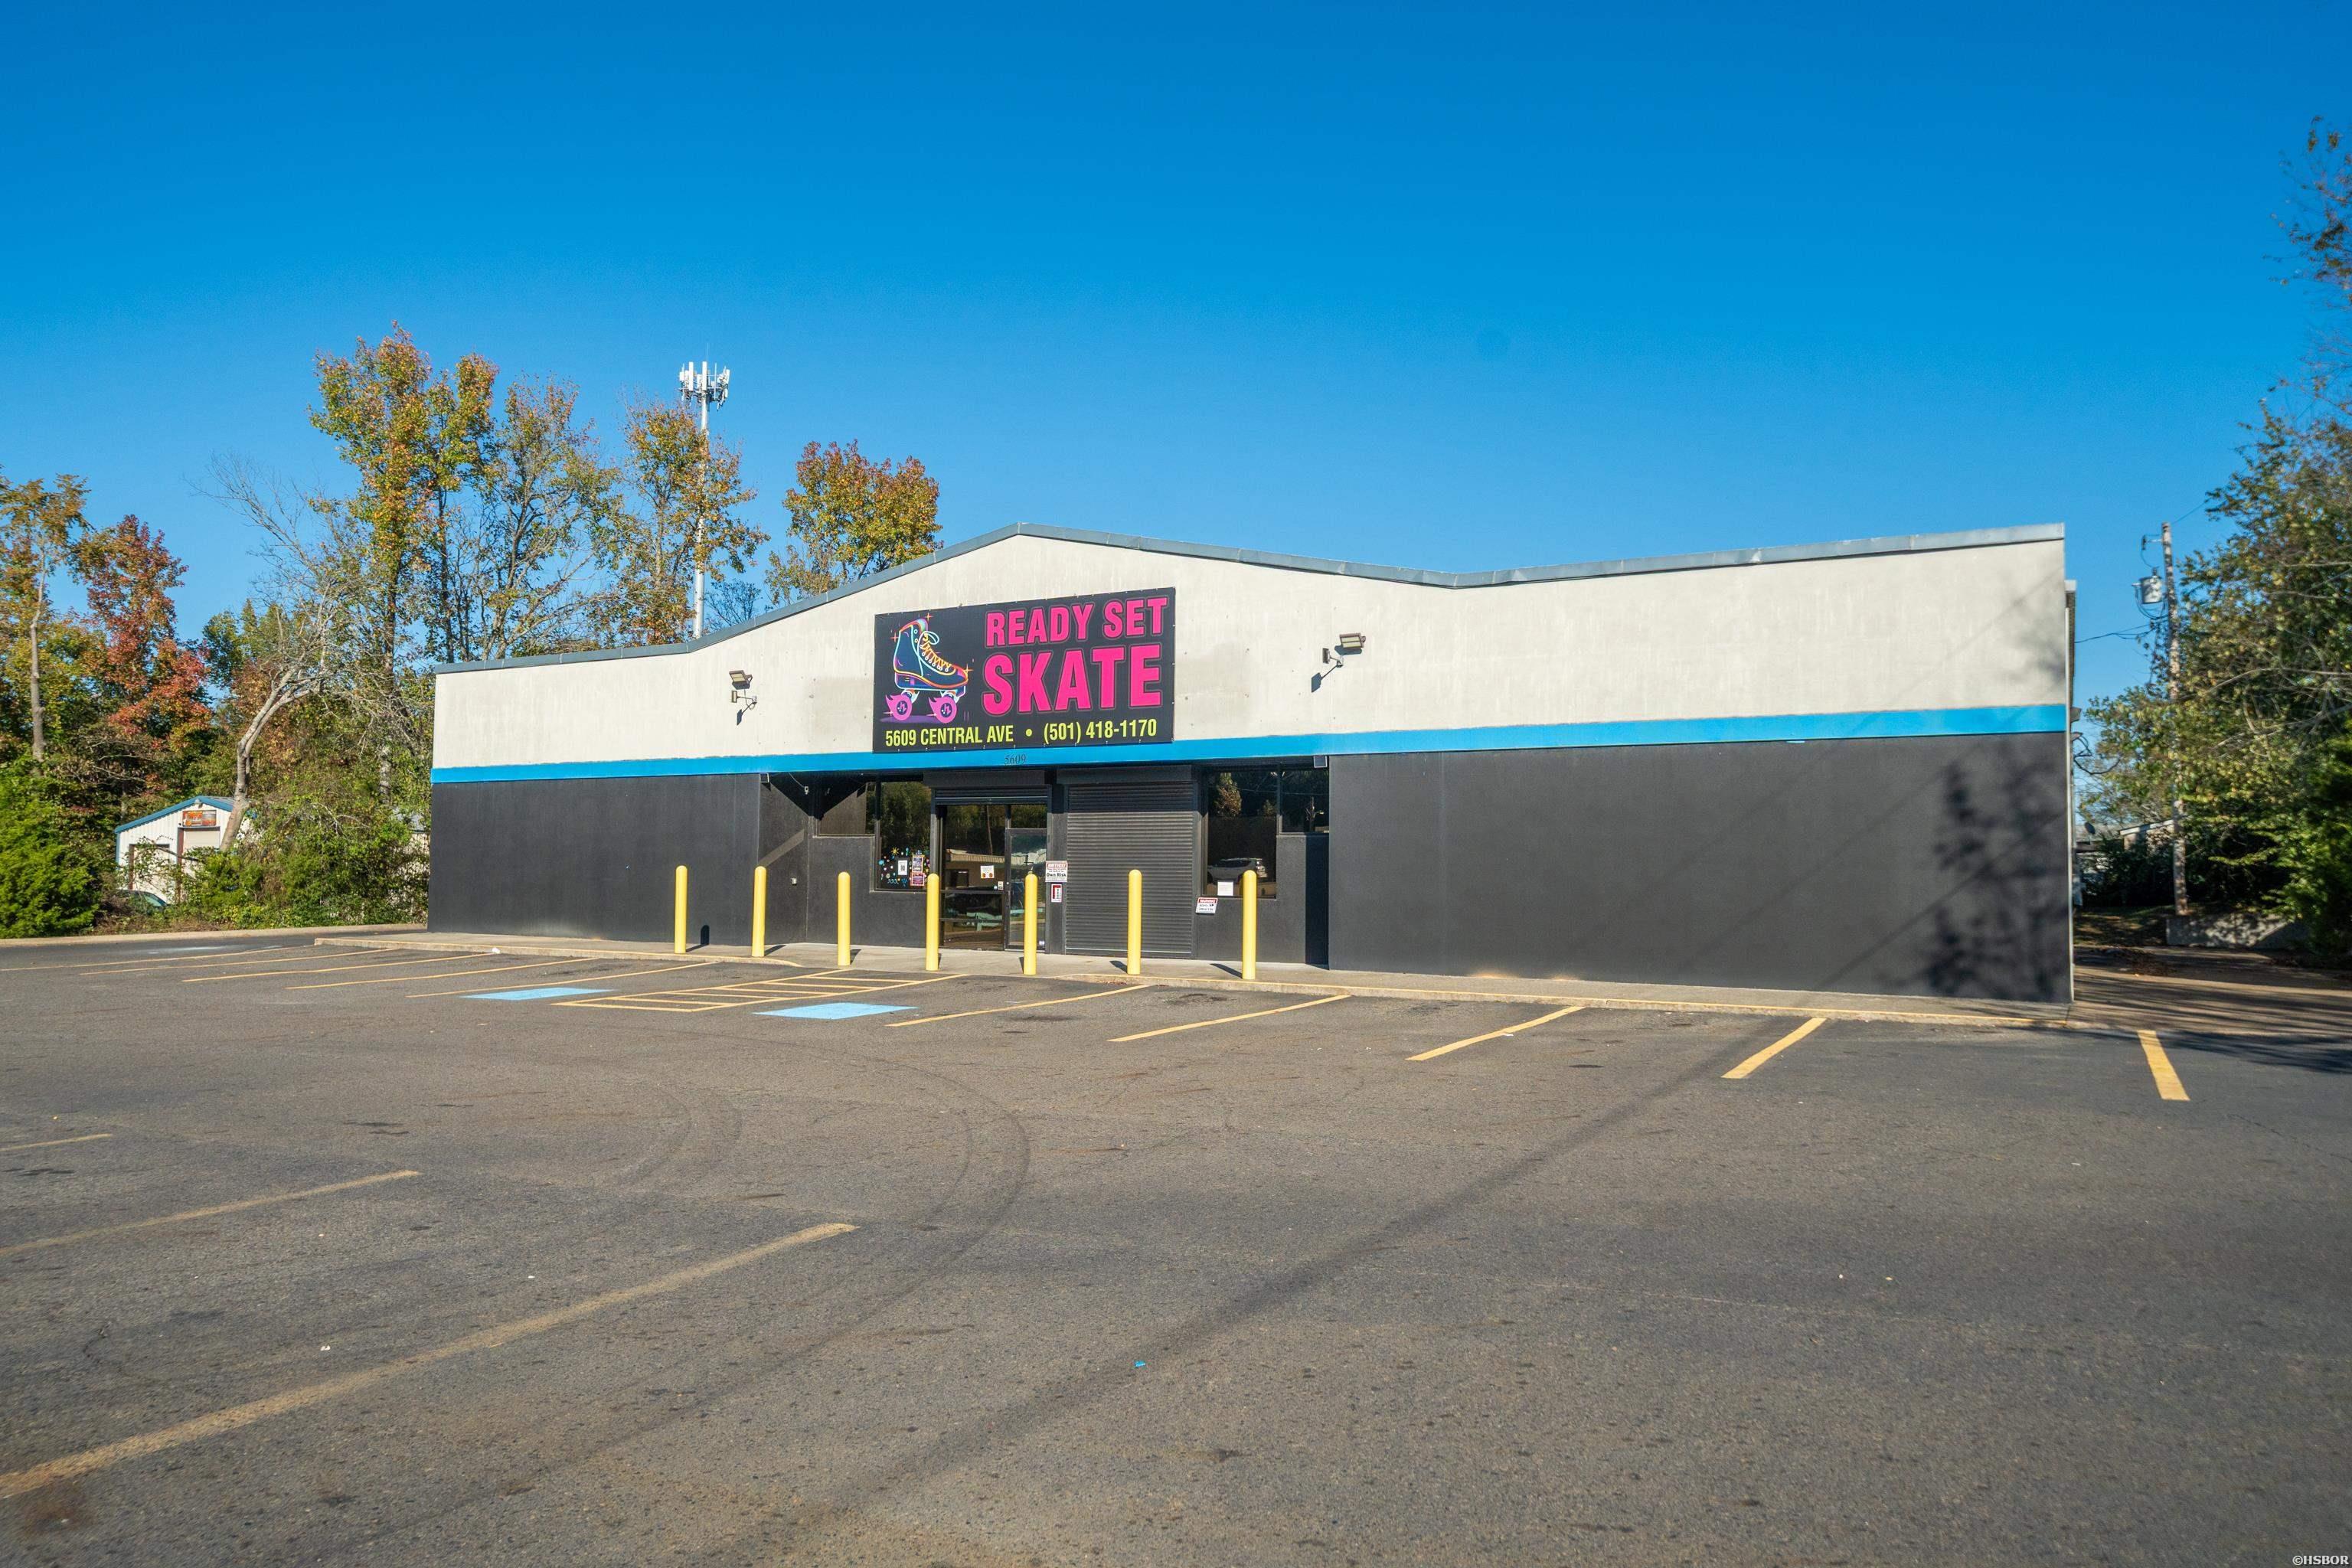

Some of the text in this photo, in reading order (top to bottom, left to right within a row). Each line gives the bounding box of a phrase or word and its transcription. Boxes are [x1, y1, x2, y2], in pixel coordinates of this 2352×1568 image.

[986, 597, 1168, 647] READY SET
[982, 644, 1161, 715] SKATE
[885, 718, 1157, 746] 5609 CENTRAL AVE (501) 418-1170
[1004, 753, 1027, 765] 5609
